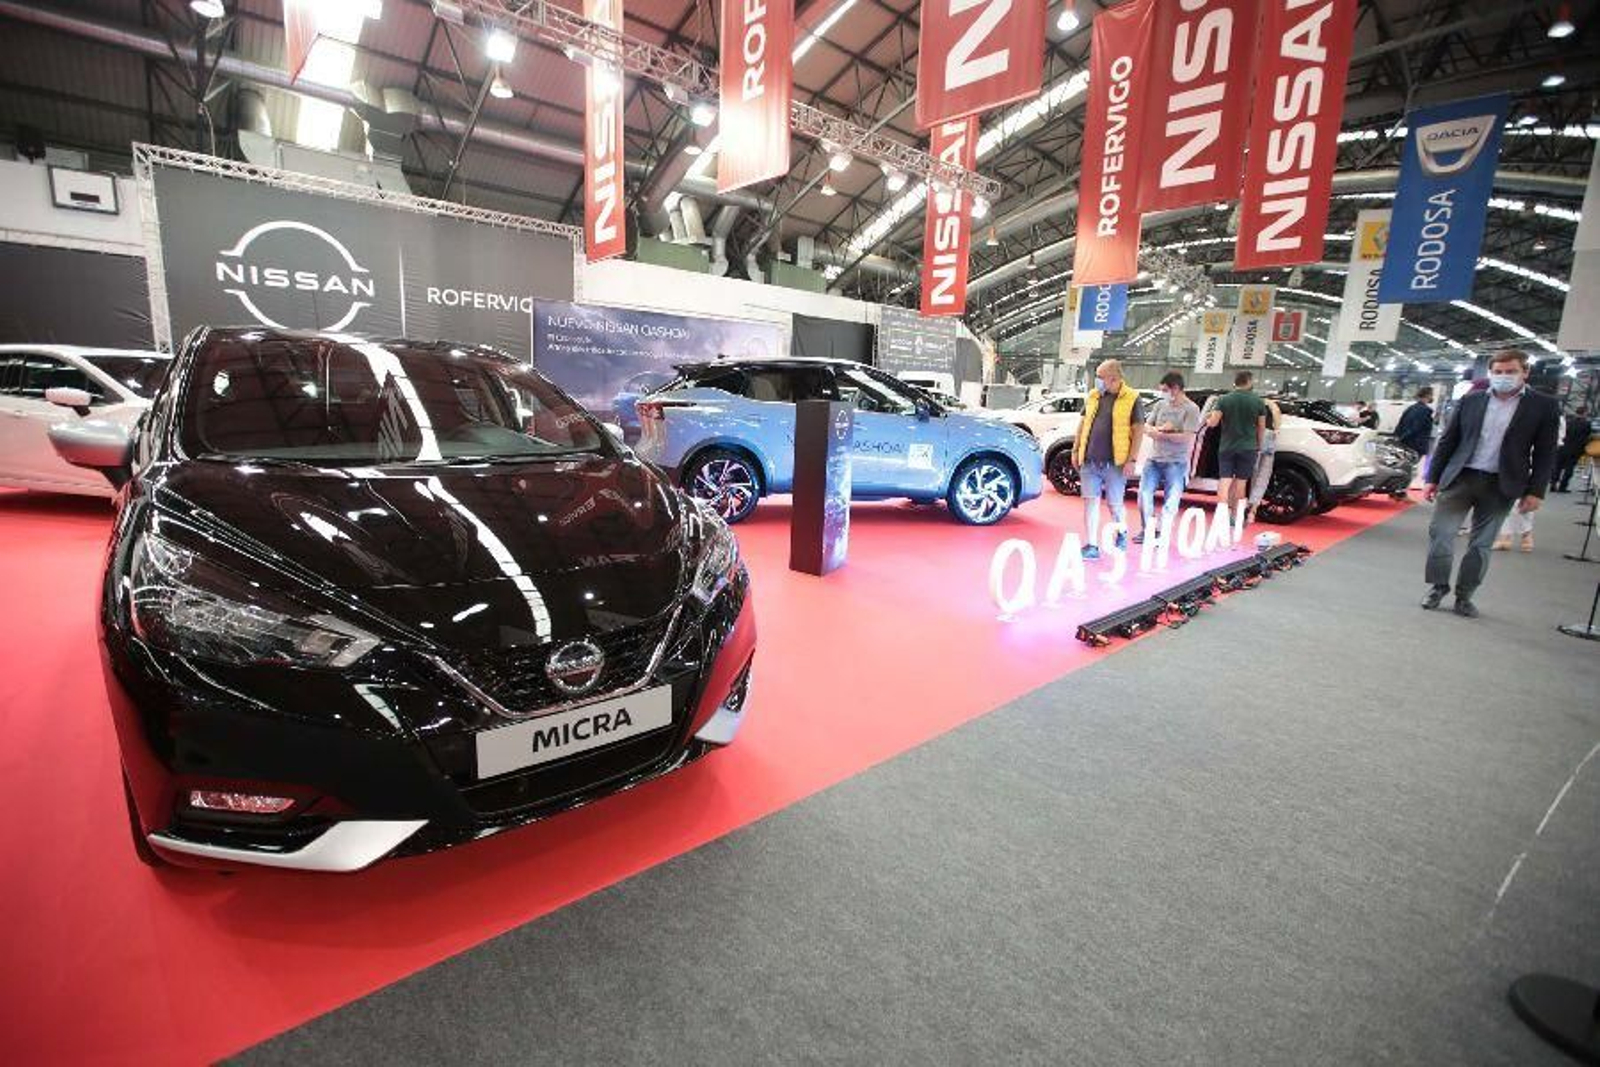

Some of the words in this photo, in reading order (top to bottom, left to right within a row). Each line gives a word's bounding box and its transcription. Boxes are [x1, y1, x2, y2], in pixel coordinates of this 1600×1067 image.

[1159, 0, 1234, 189] NIS
[1097, 56, 1133, 237] ROFERVIGO
[1427, 127, 1480, 142] DACIA
[1411, 188, 1456, 290] RODOSA
[215, 261, 376, 298] NISSAN
[532, 707, 633, 753] MICRA
